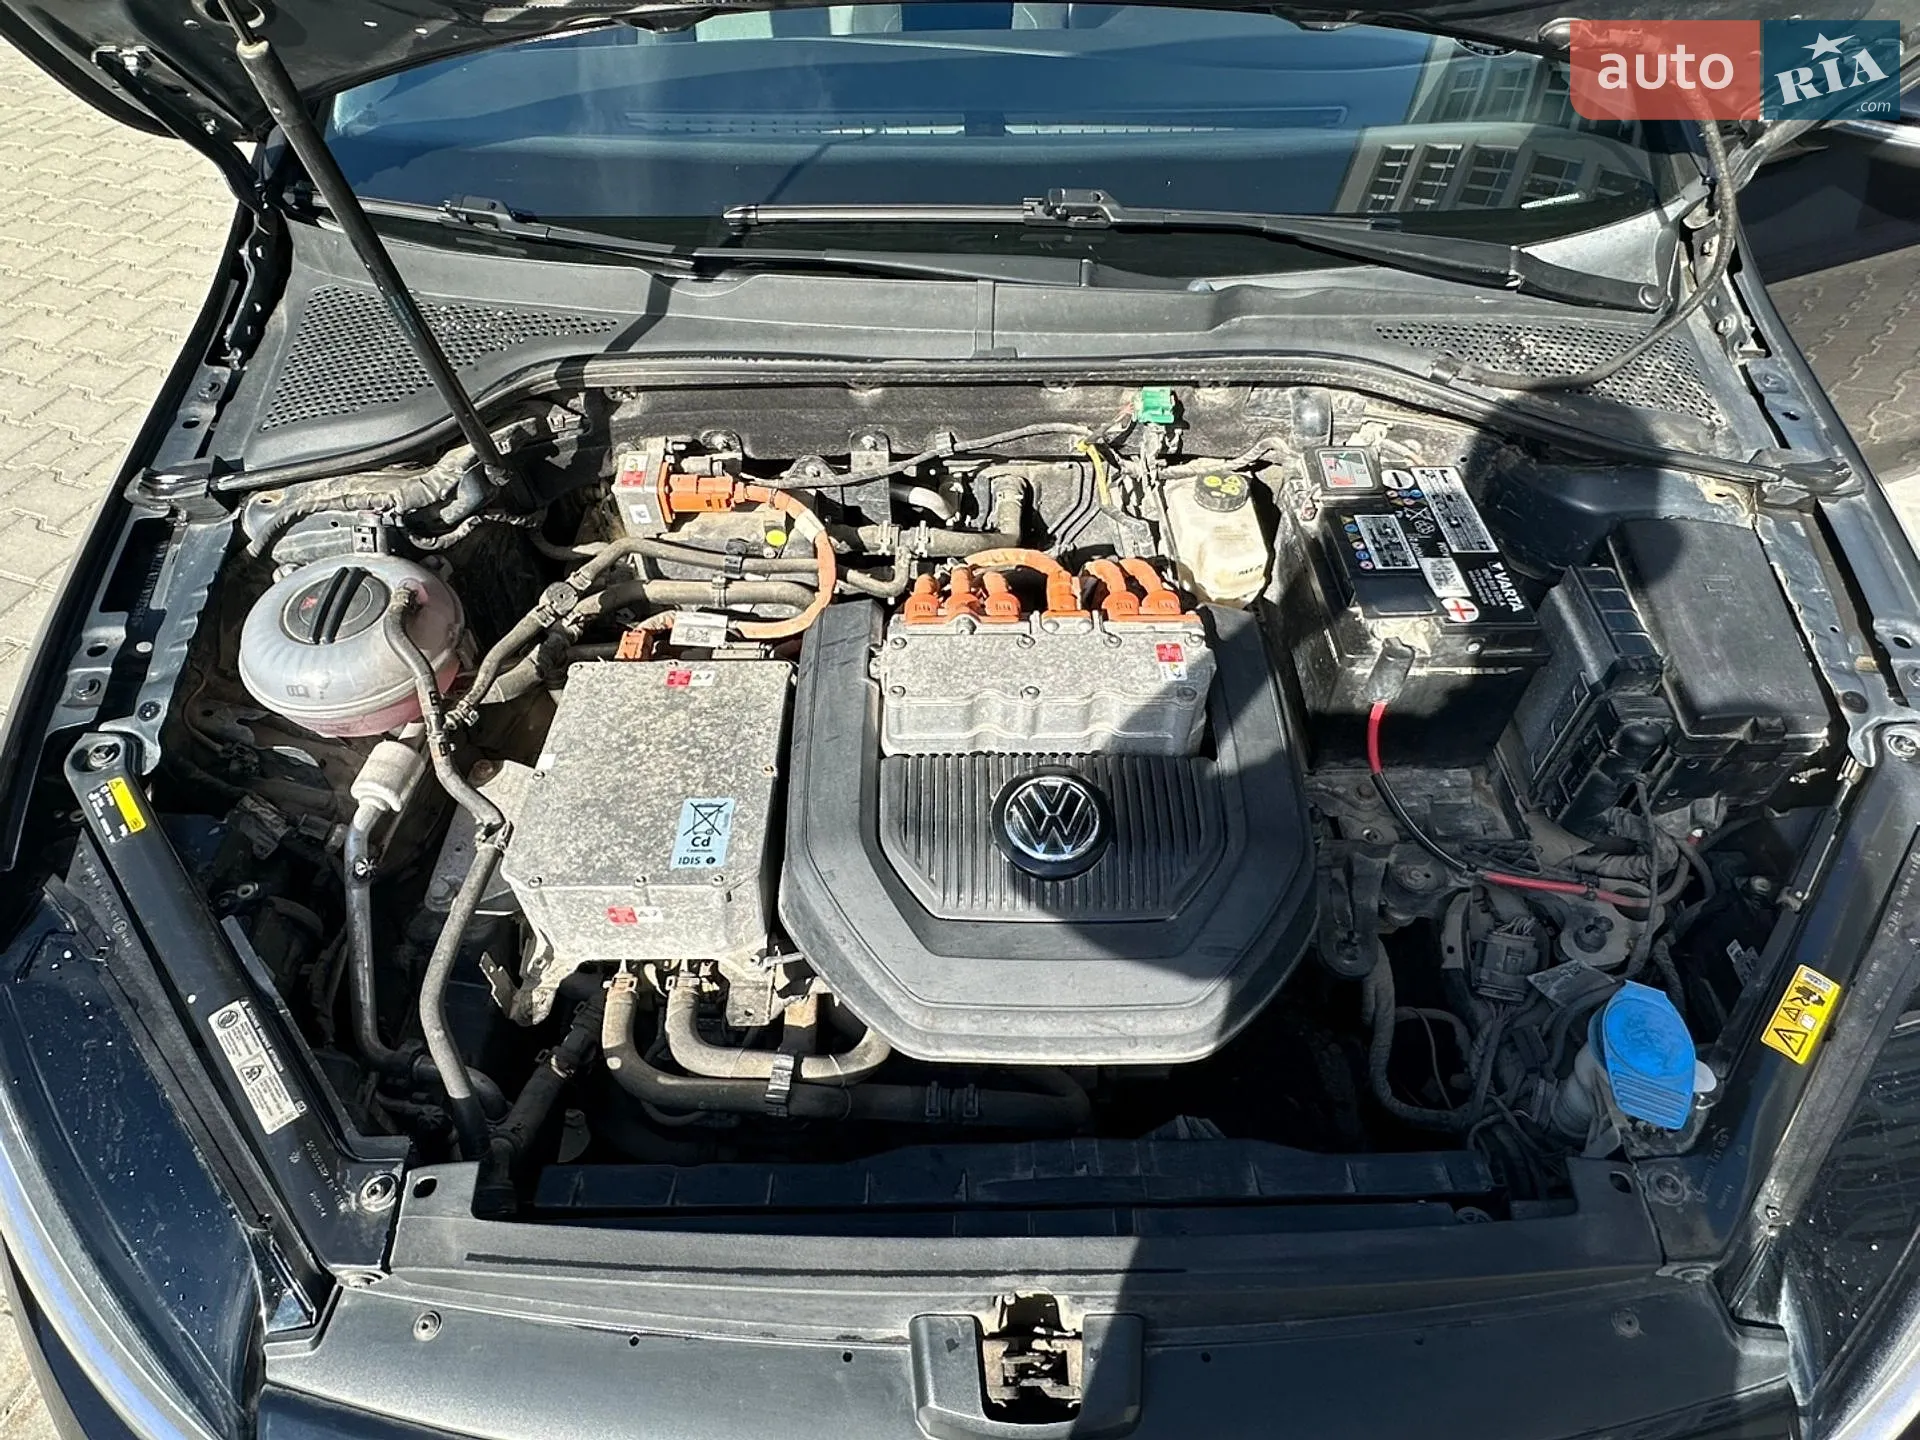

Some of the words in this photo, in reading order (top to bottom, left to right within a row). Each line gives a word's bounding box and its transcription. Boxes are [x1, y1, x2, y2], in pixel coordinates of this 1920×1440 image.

[1494, 571, 1525, 612] VARTA
[691, 836, 711, 847] Cd
[678, 856, 701, 865] IDIS
